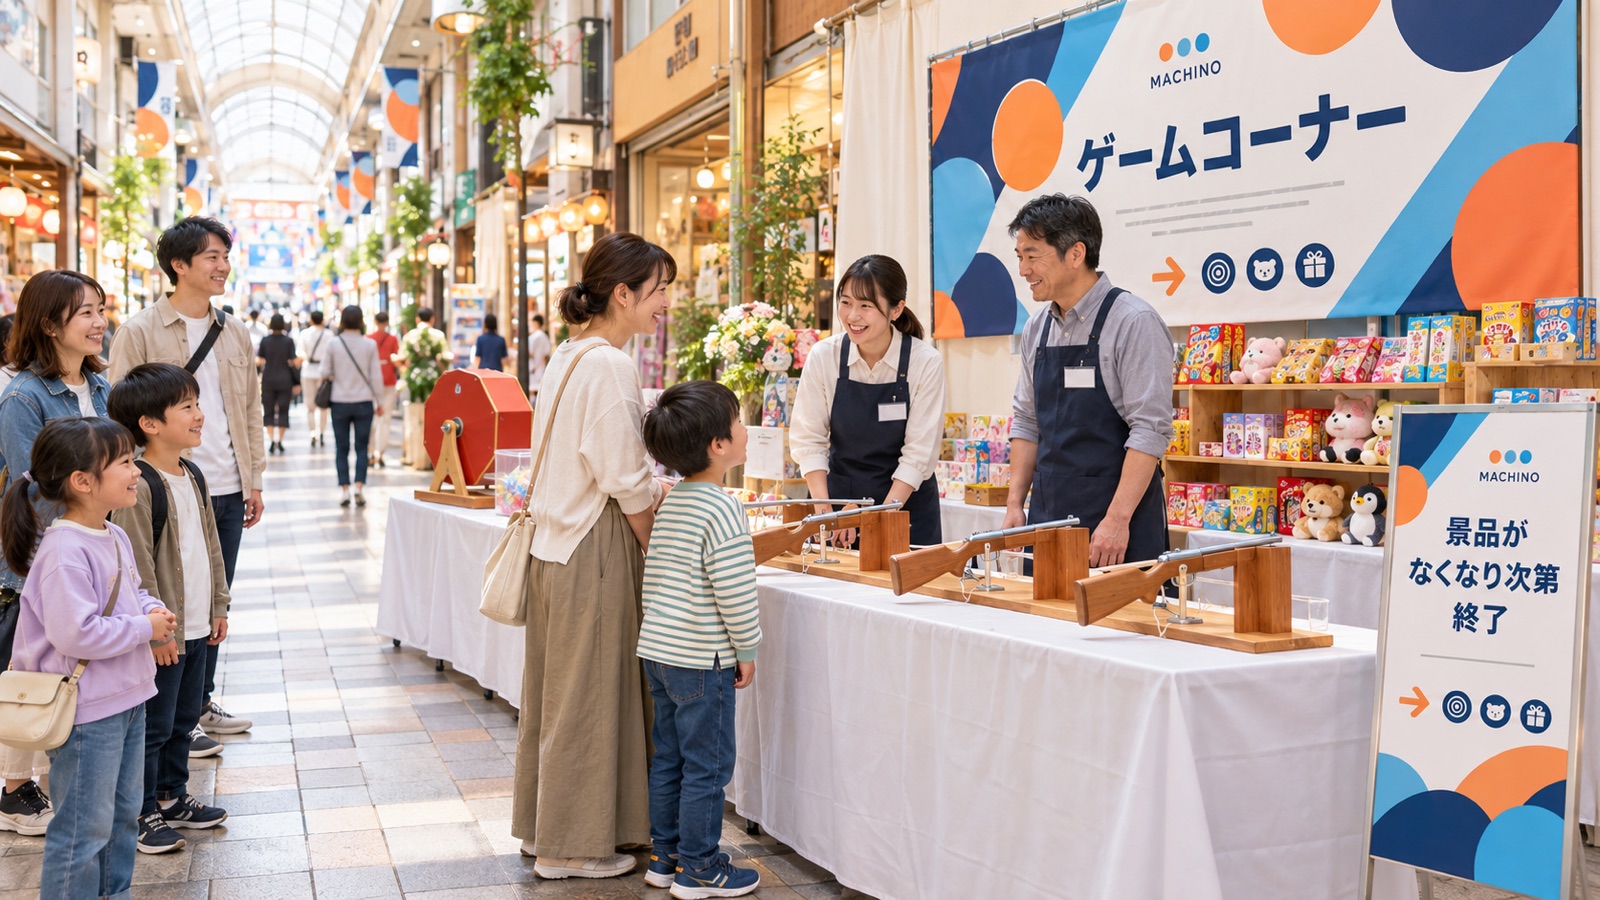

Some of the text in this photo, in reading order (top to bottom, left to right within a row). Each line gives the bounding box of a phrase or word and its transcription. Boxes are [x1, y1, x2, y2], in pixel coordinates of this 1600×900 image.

[1150, 60, 1222, 89] MACHINO
[1076, 93, 1407, 193] ゲームコーナー
[1479, 471, 1540, 483] MACHINO
[1446, 516, 1529, 549] 景品が
[1408, 557, 1561, 595] なくなり次第
[1452, 601, 1508, 635] 終了
